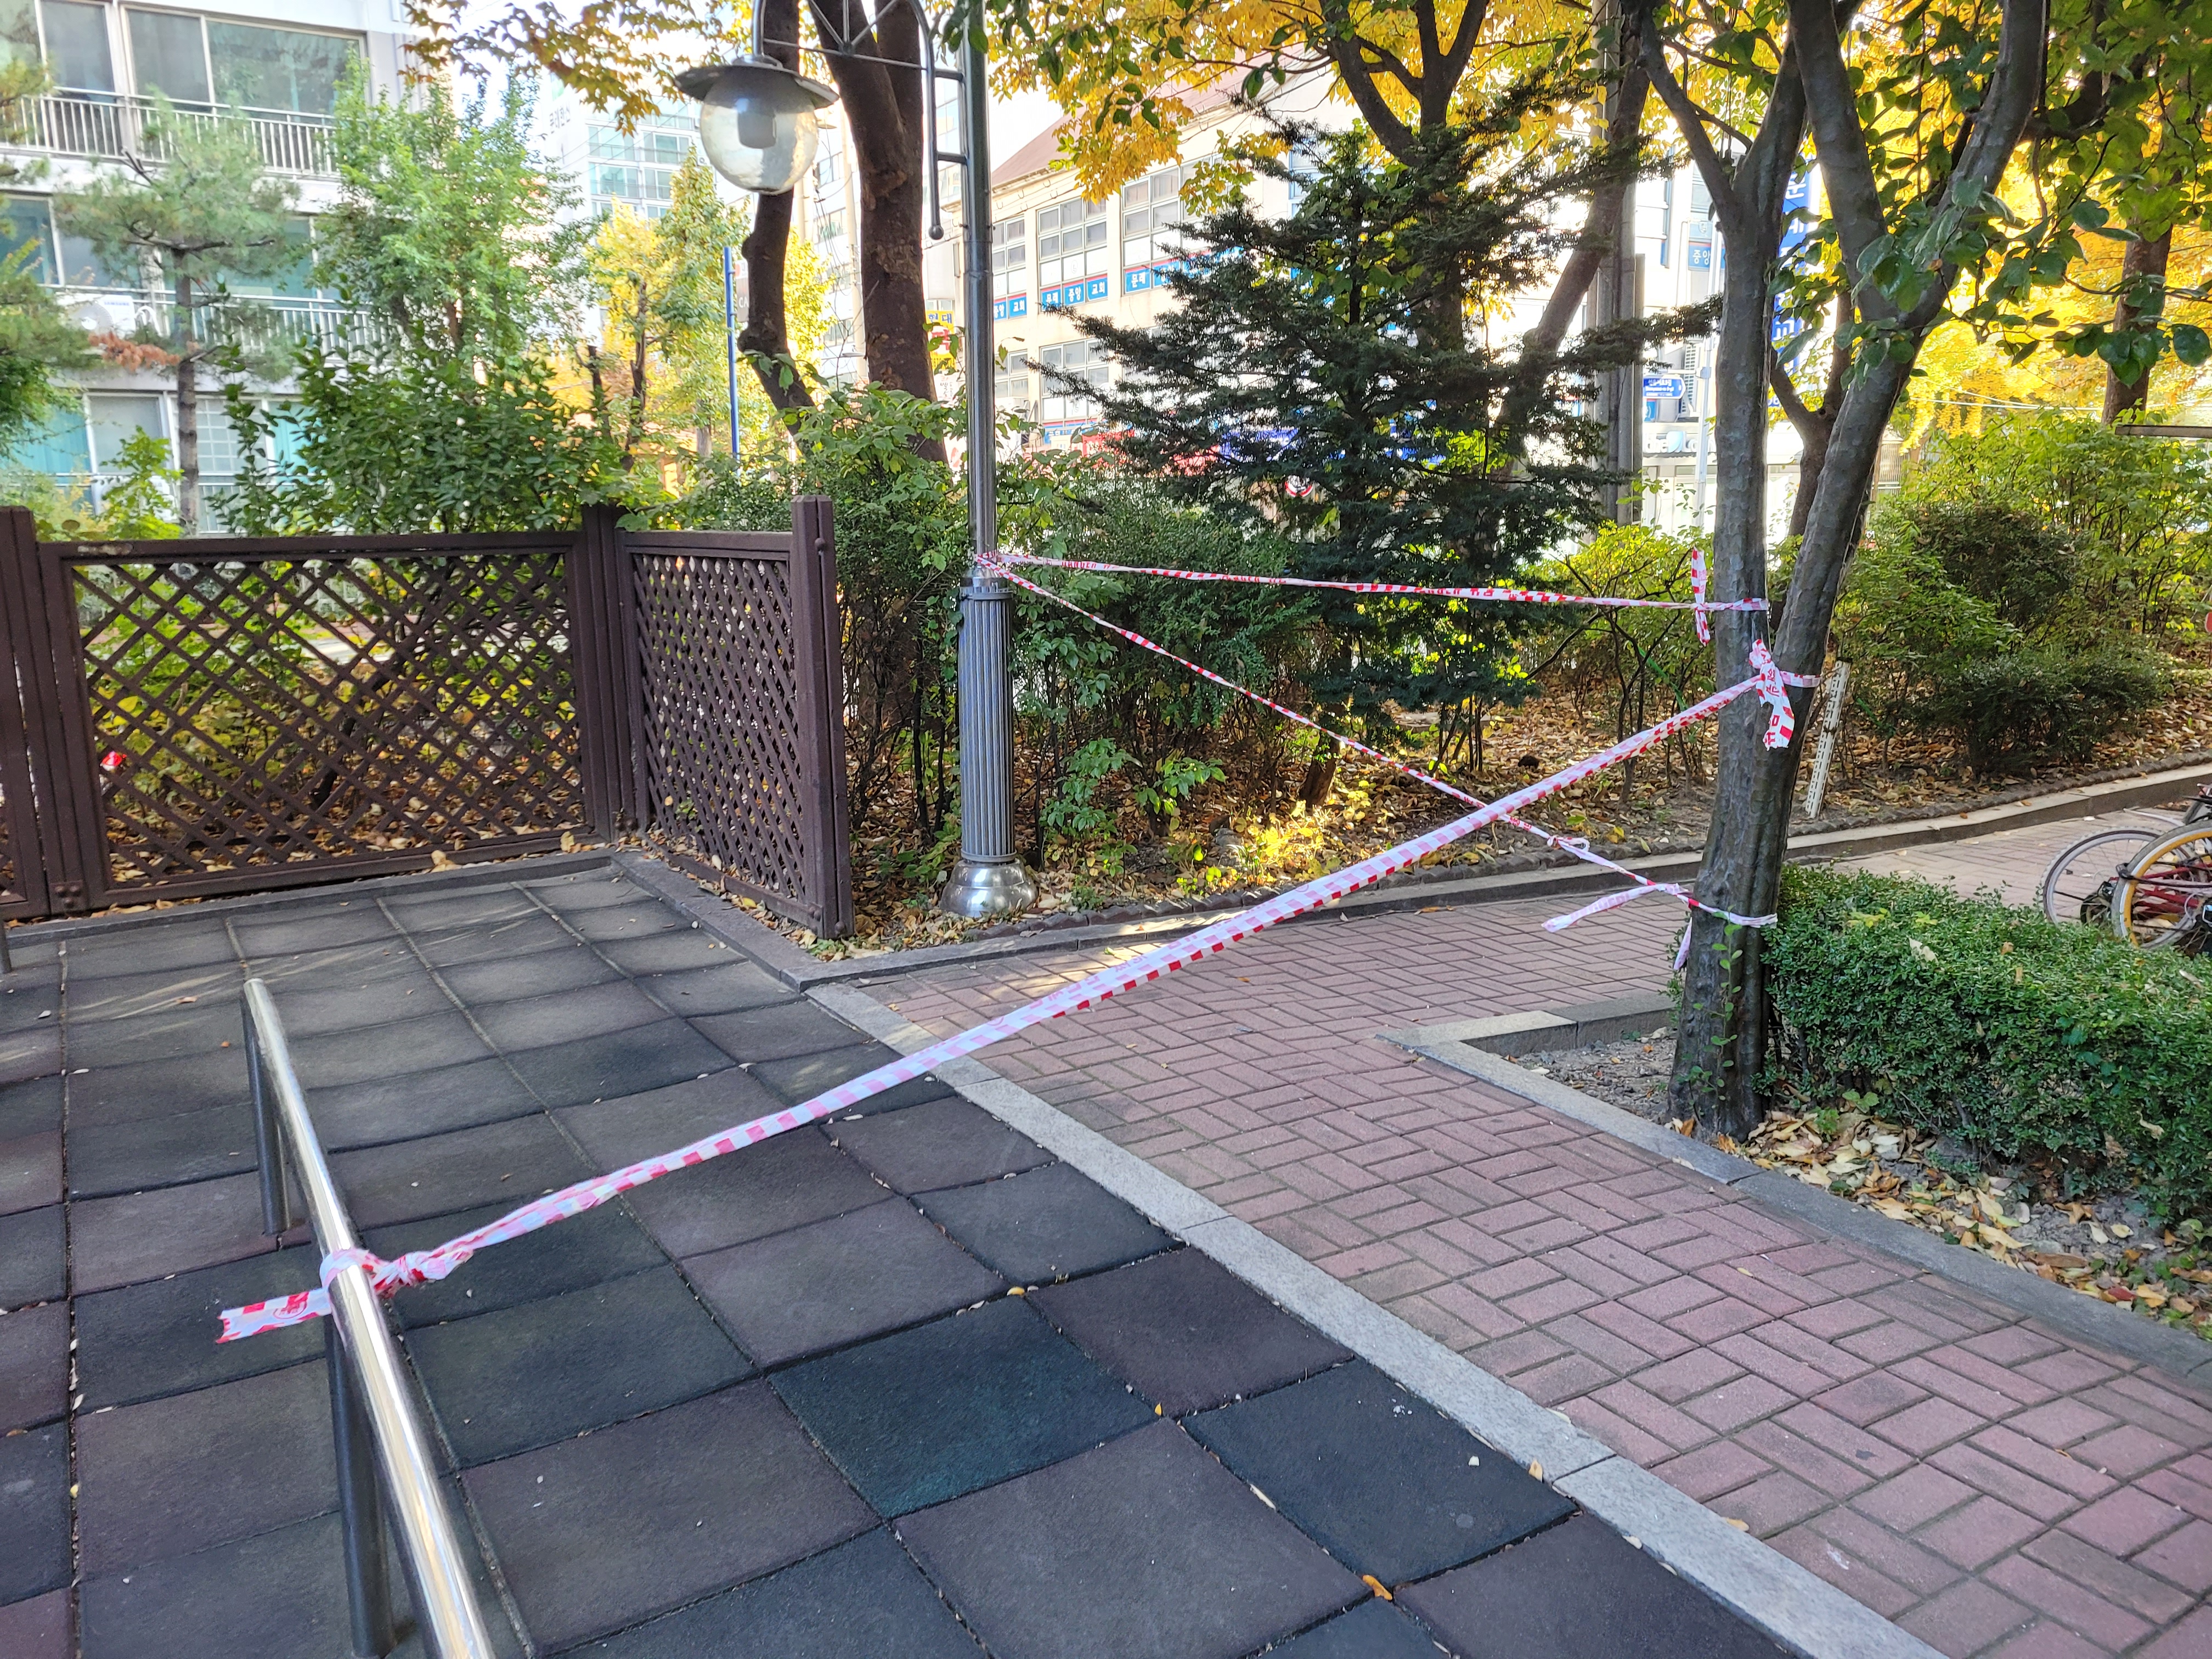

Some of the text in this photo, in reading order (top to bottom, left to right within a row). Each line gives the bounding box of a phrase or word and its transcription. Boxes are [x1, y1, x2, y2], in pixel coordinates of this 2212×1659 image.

[1068, 286, 1081, 302] 중앙
[1091, 281, 1105, 295] 교회
[1013, 300, 1025, 312] 교회
